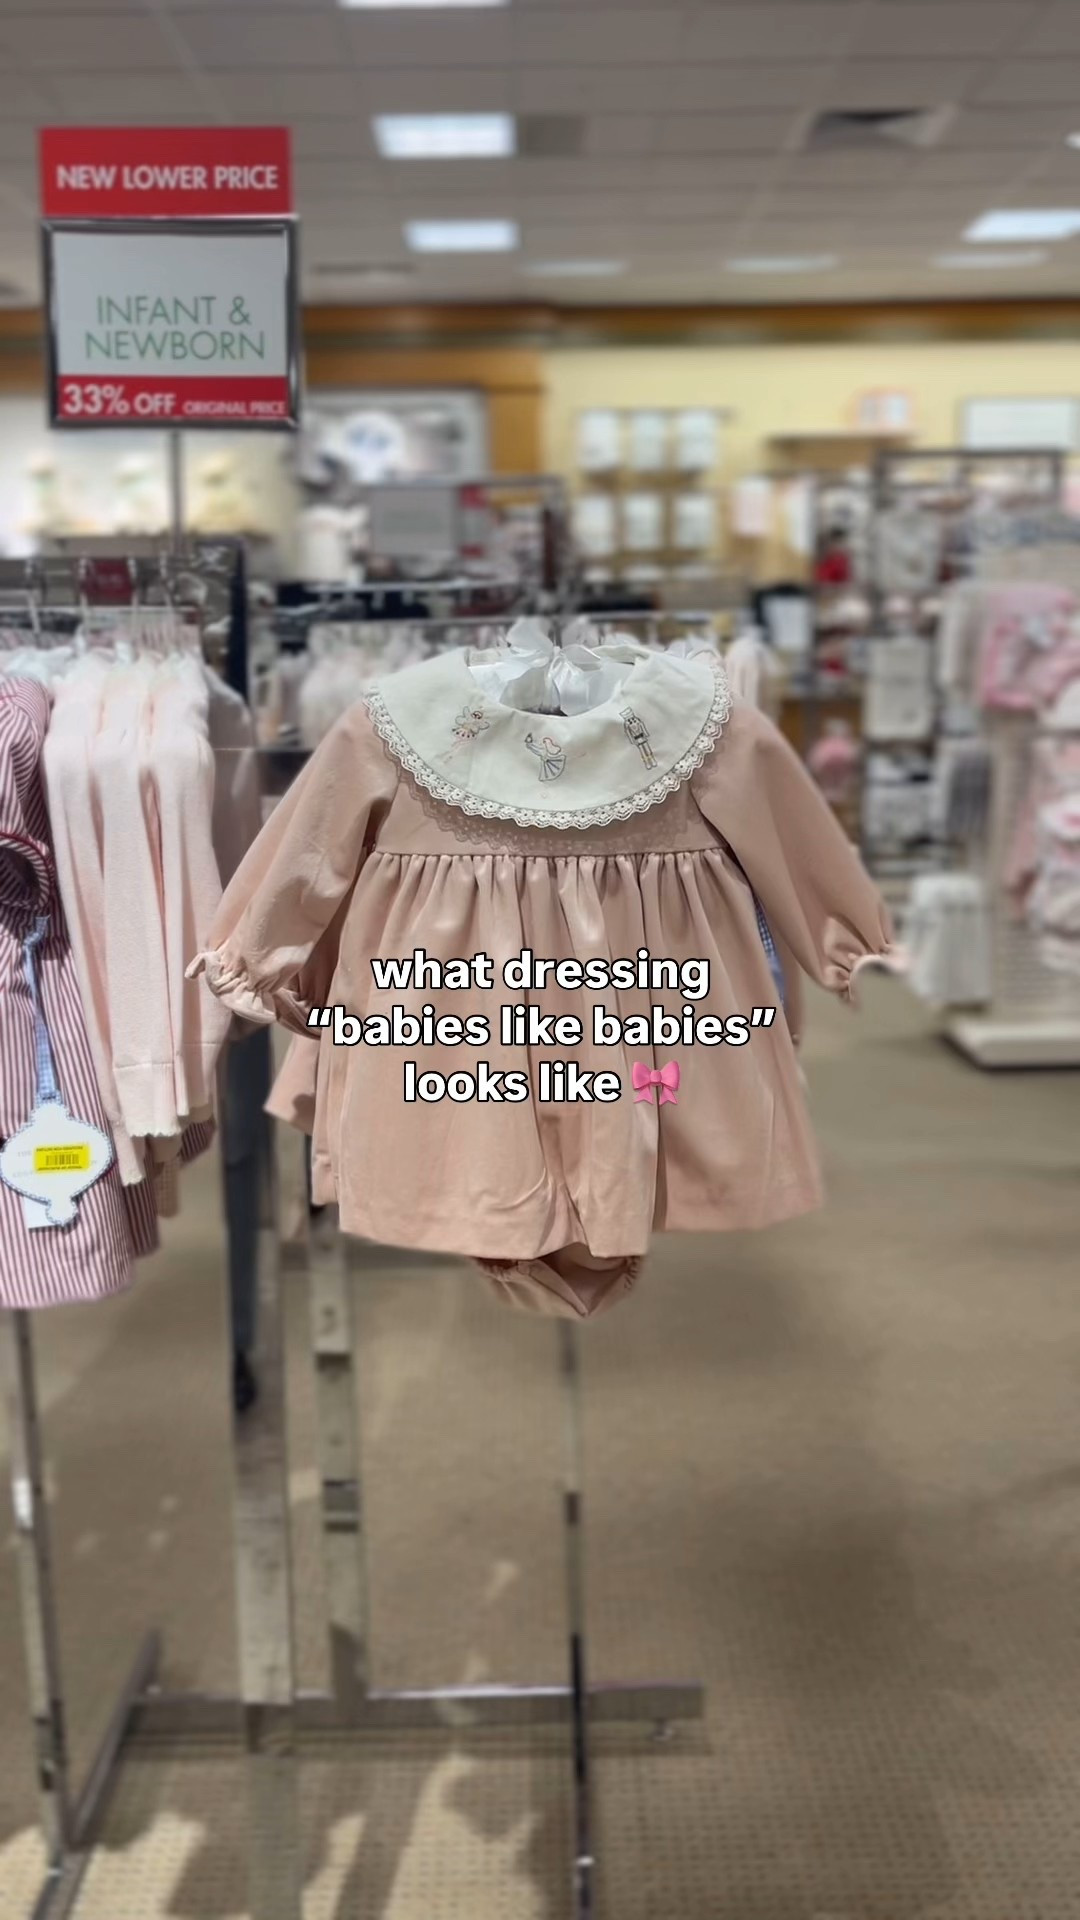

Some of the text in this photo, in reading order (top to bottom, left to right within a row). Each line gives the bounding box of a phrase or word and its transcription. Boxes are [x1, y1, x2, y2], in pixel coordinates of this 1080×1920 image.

[57, 165, 278, 189] NEW LOWER PRICE
[97, 296, 251, 325] INFANT &
[85, 330, 264, 360] NEWBORN
[64, 384, 286, 414] 33% OFF ORIGINAL PRICE
